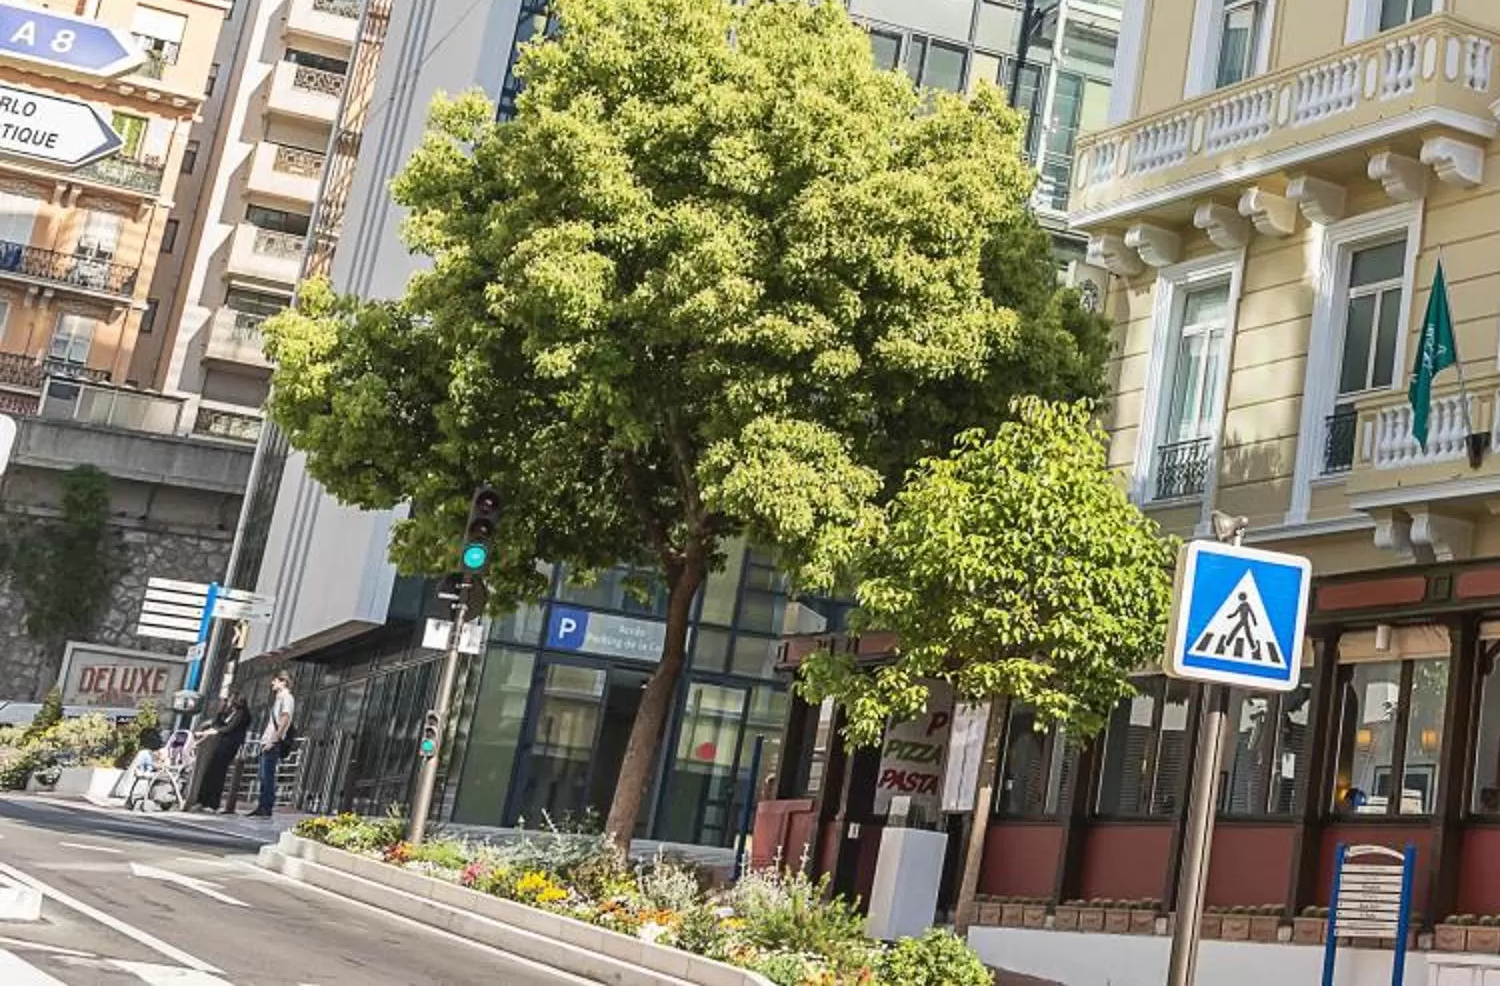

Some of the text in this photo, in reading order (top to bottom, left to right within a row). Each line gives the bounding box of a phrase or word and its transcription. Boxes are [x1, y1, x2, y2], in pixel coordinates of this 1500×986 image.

[10, 20, 77, 54] A 8
[2, 123, 59, 149] TIQUE
[559, 617, 577, 639] P
[79, 665, 168, 694] DELUXE
[883, 739, 942, 766] PIZZA
[878, 769, 939, 795] PASTA
